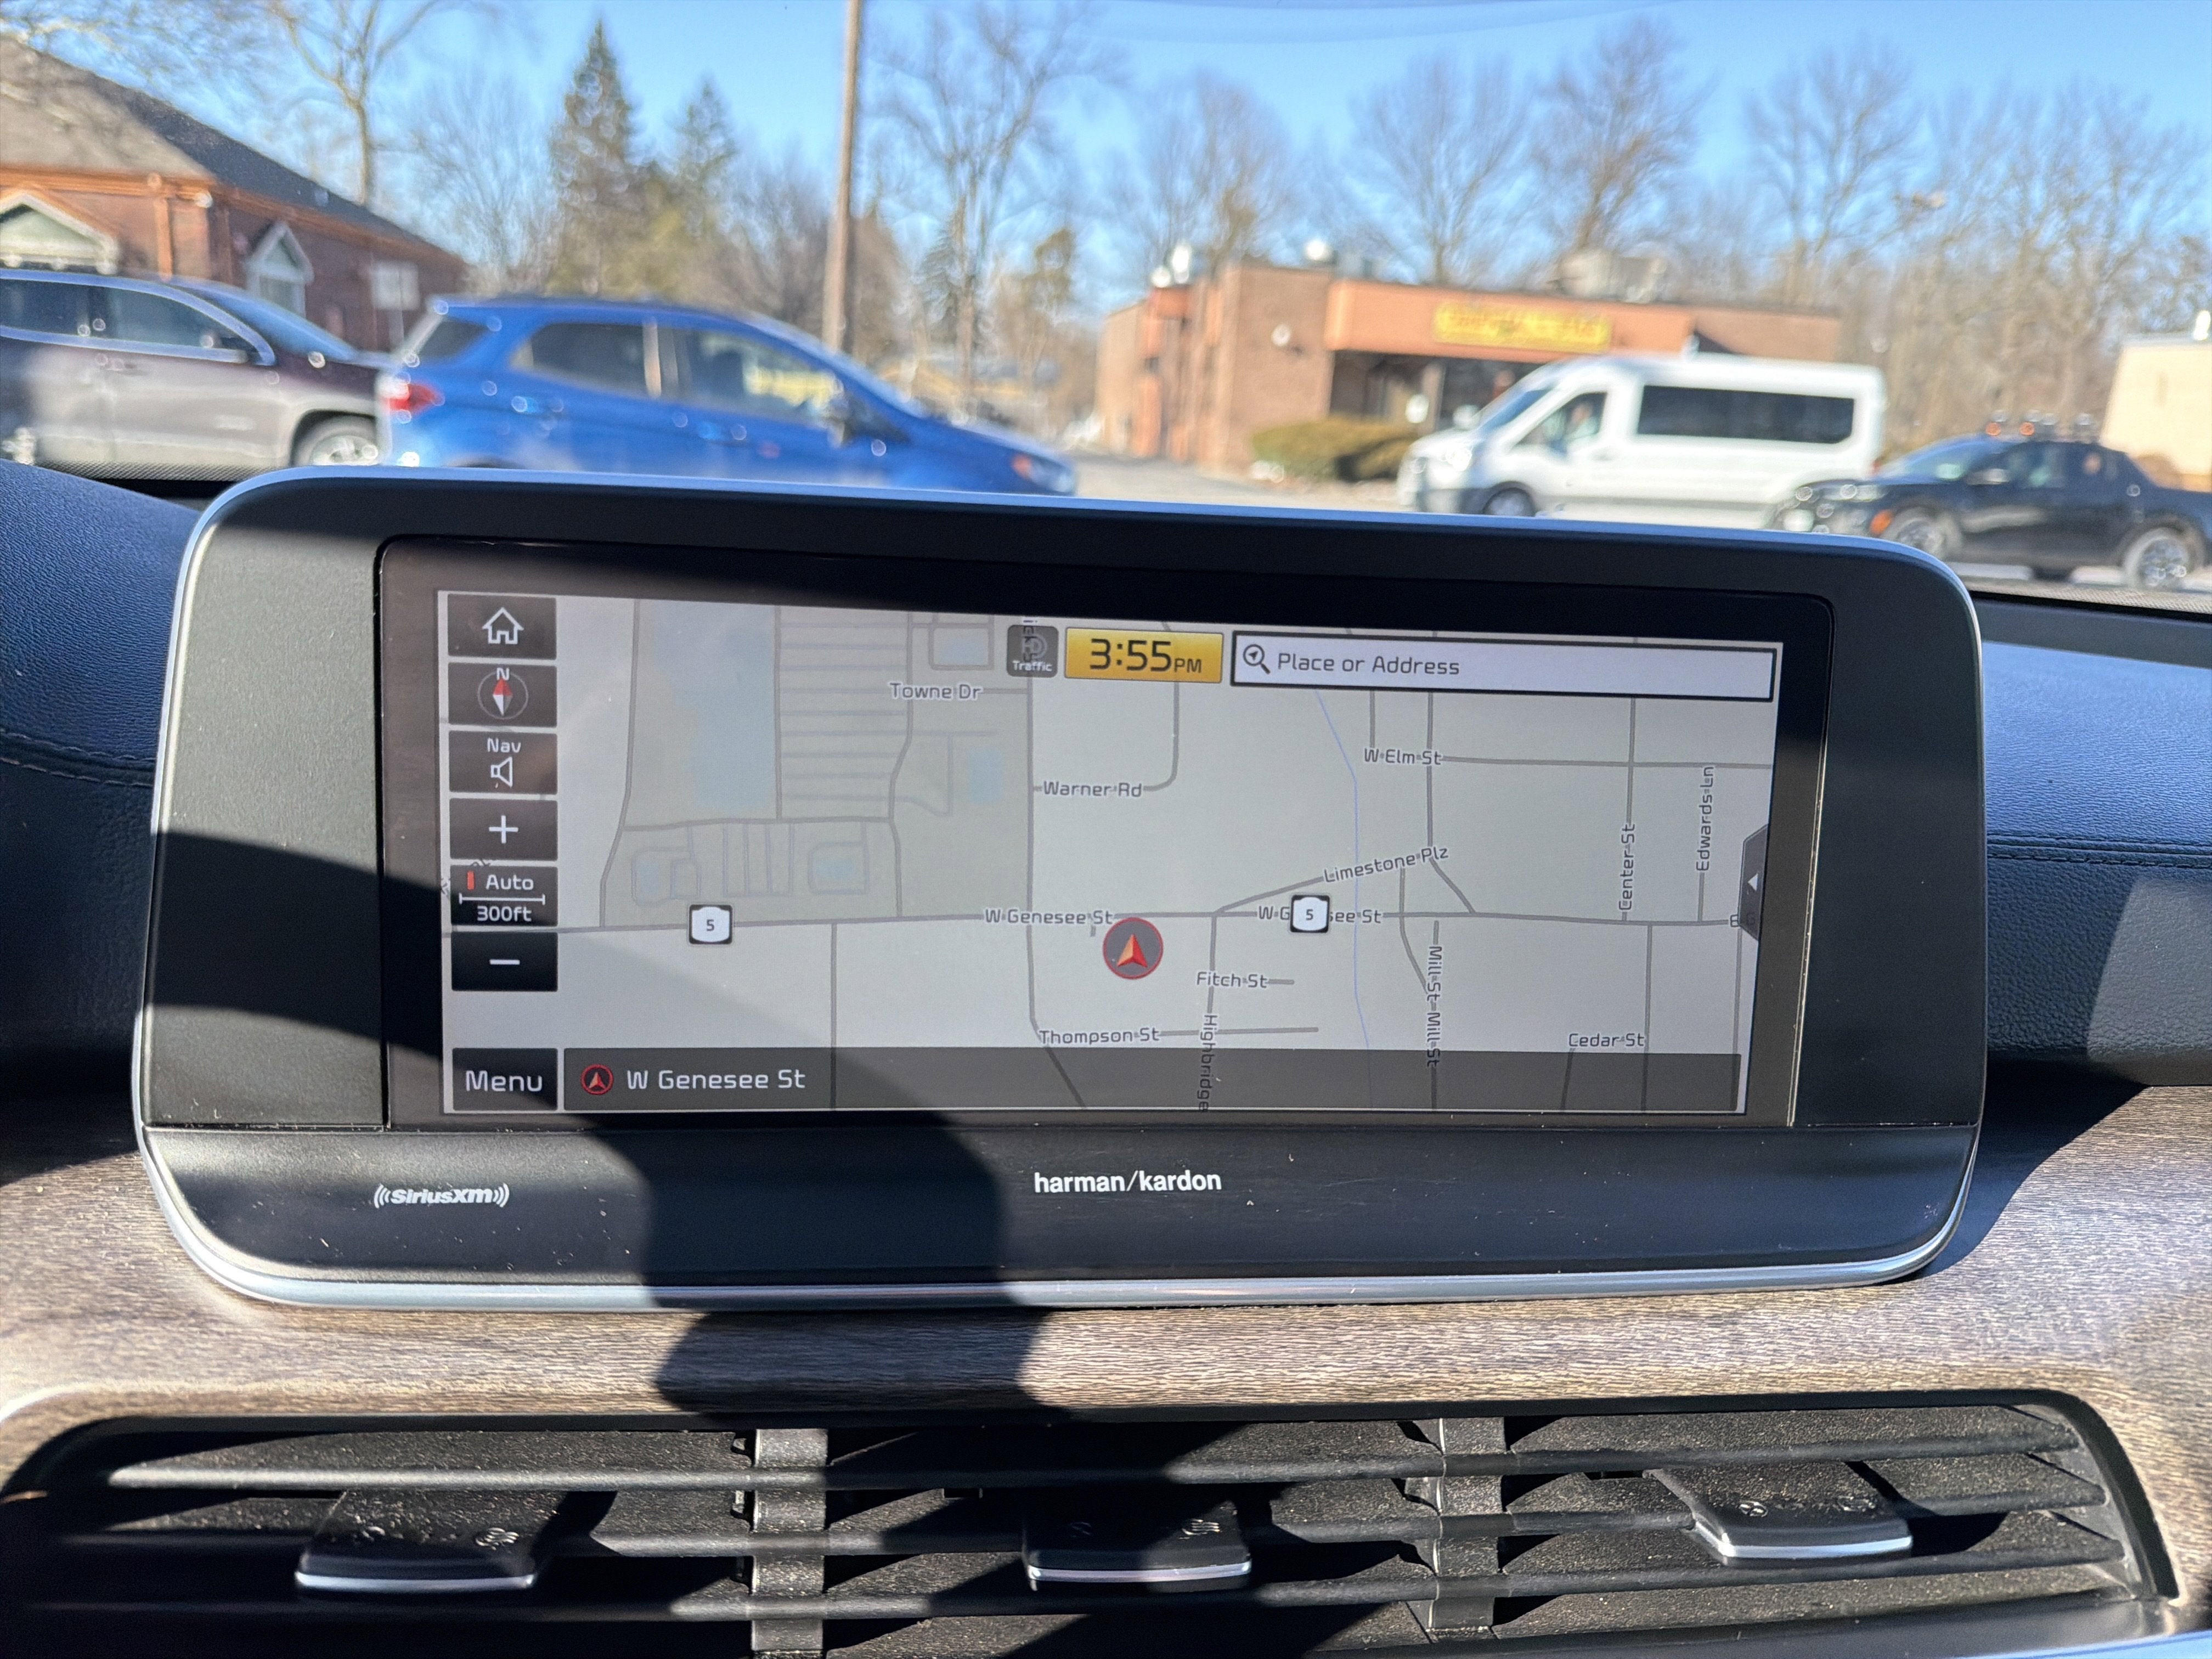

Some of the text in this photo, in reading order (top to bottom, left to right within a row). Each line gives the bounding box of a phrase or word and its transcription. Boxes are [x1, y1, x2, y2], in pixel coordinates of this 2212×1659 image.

[1278, 653, 1460, 675] Place or Address
[496, 668, 510, 681] N
[890, 682, 983, 700] Towne Dr
[487, 738, 521, 753] Nav
[1364, 748, 1442, 765] W Elm St
[1043, 781, 1142, 798] Warner Rd
[1696, 766, 1714, 872] Edwards Ln
[1324, 847, 1449, 883] Limestone Plz
[1619, 823, 1635, 911] Center St
[486, 874, 534, 890] Auto
[477, 905, 532, 922] 300ft
[985, 909, 1113, 926] W Genesee St
[1259, 906, 1274, 920] W
[1362, 909, 1382, 924] St
[1306, 909, 1314, 921] 5
[706, 919, 715, 932] 5
[1197, 971, 1268, 988] Fitch St
[1427, 946, 1442, 1002] Mill St
[1040, 1027, 1160, 1045] Thompson St
[1426, 1012, 1441, 1068] Mill St
[1568, 1032, 1645, 1047] Cedar St
[1197, 1015, 1218, 1113] Highbridge
[465, 1069, 543, 1092] Menu
[627, 1069, 806, 1090] W Genesee St
[1034, 1169, 1222, 1193] harman/kardon
